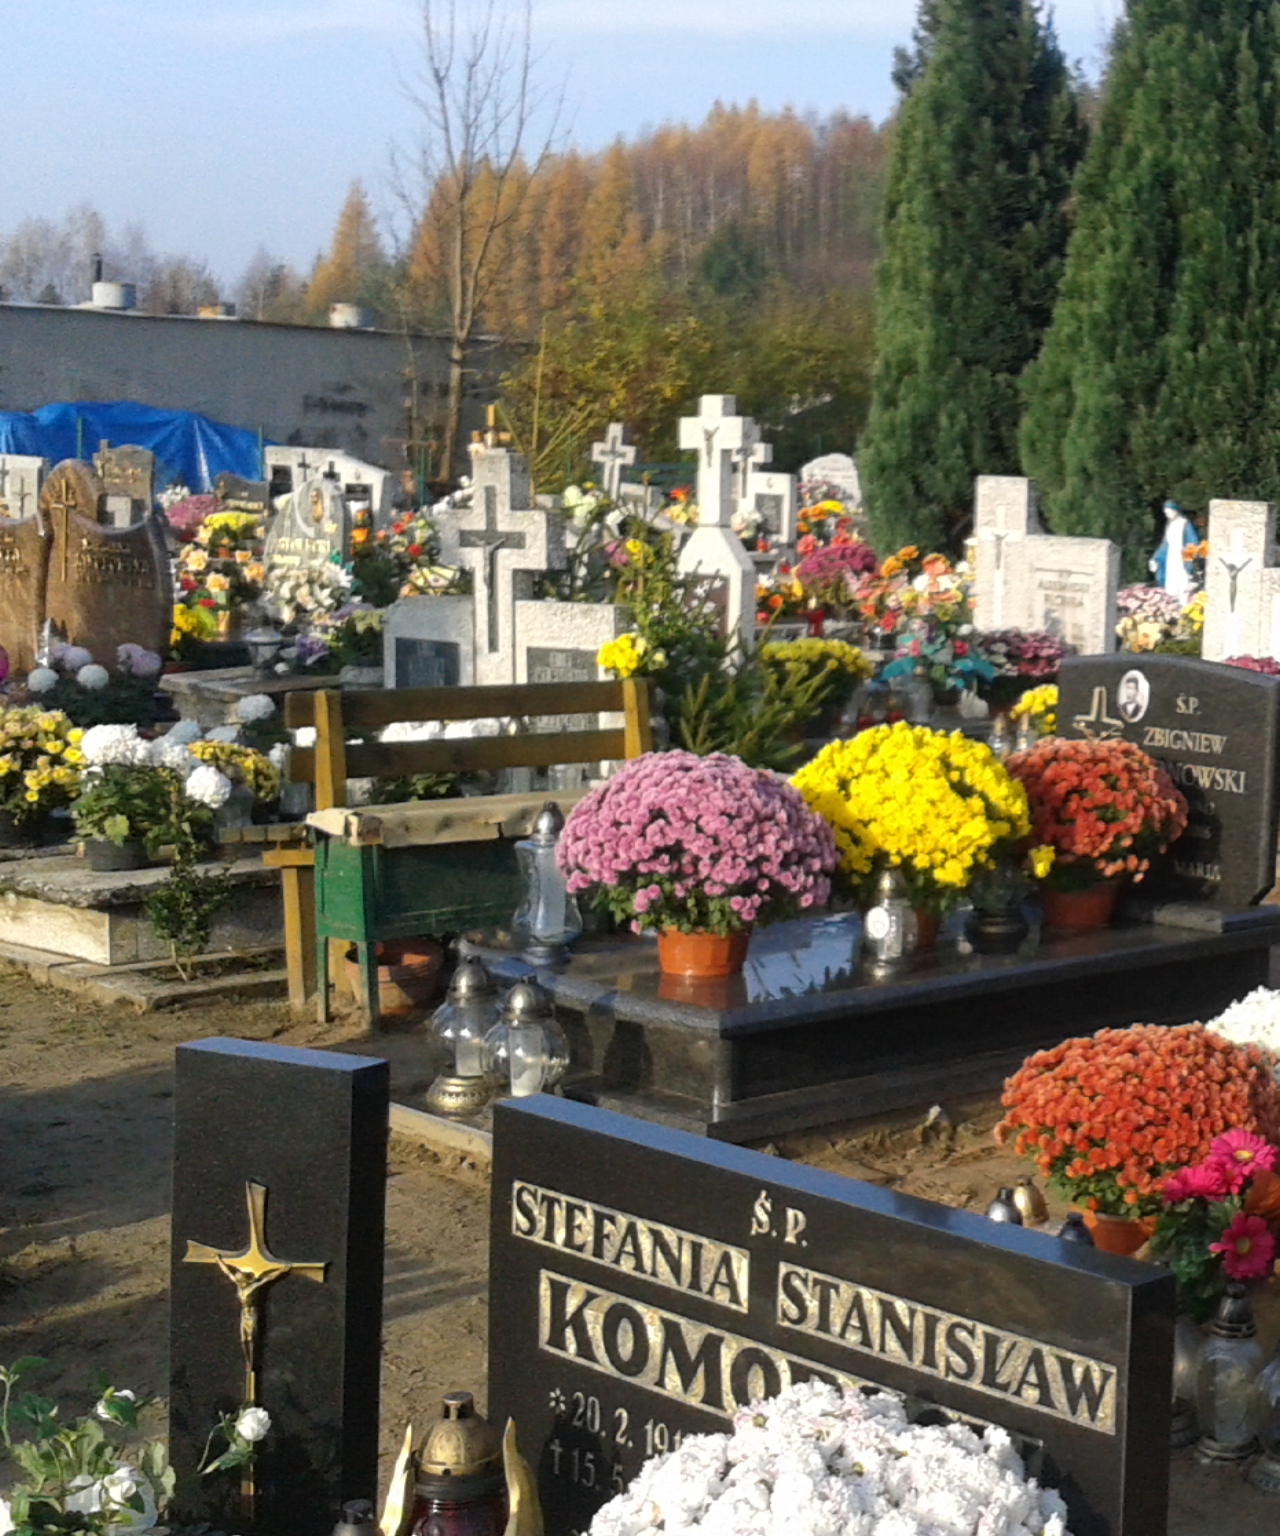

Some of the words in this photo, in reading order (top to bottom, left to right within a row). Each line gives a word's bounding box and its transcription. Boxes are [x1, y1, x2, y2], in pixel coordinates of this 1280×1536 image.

[1143, 727, 1228, 755] ZBIGNIEW
[1168, 761, 1246, 794] NOWSKI
[514, 1182, 748, 1310] STEFANIA
[779, 1265, 1116, 1426] STANISŁAW
